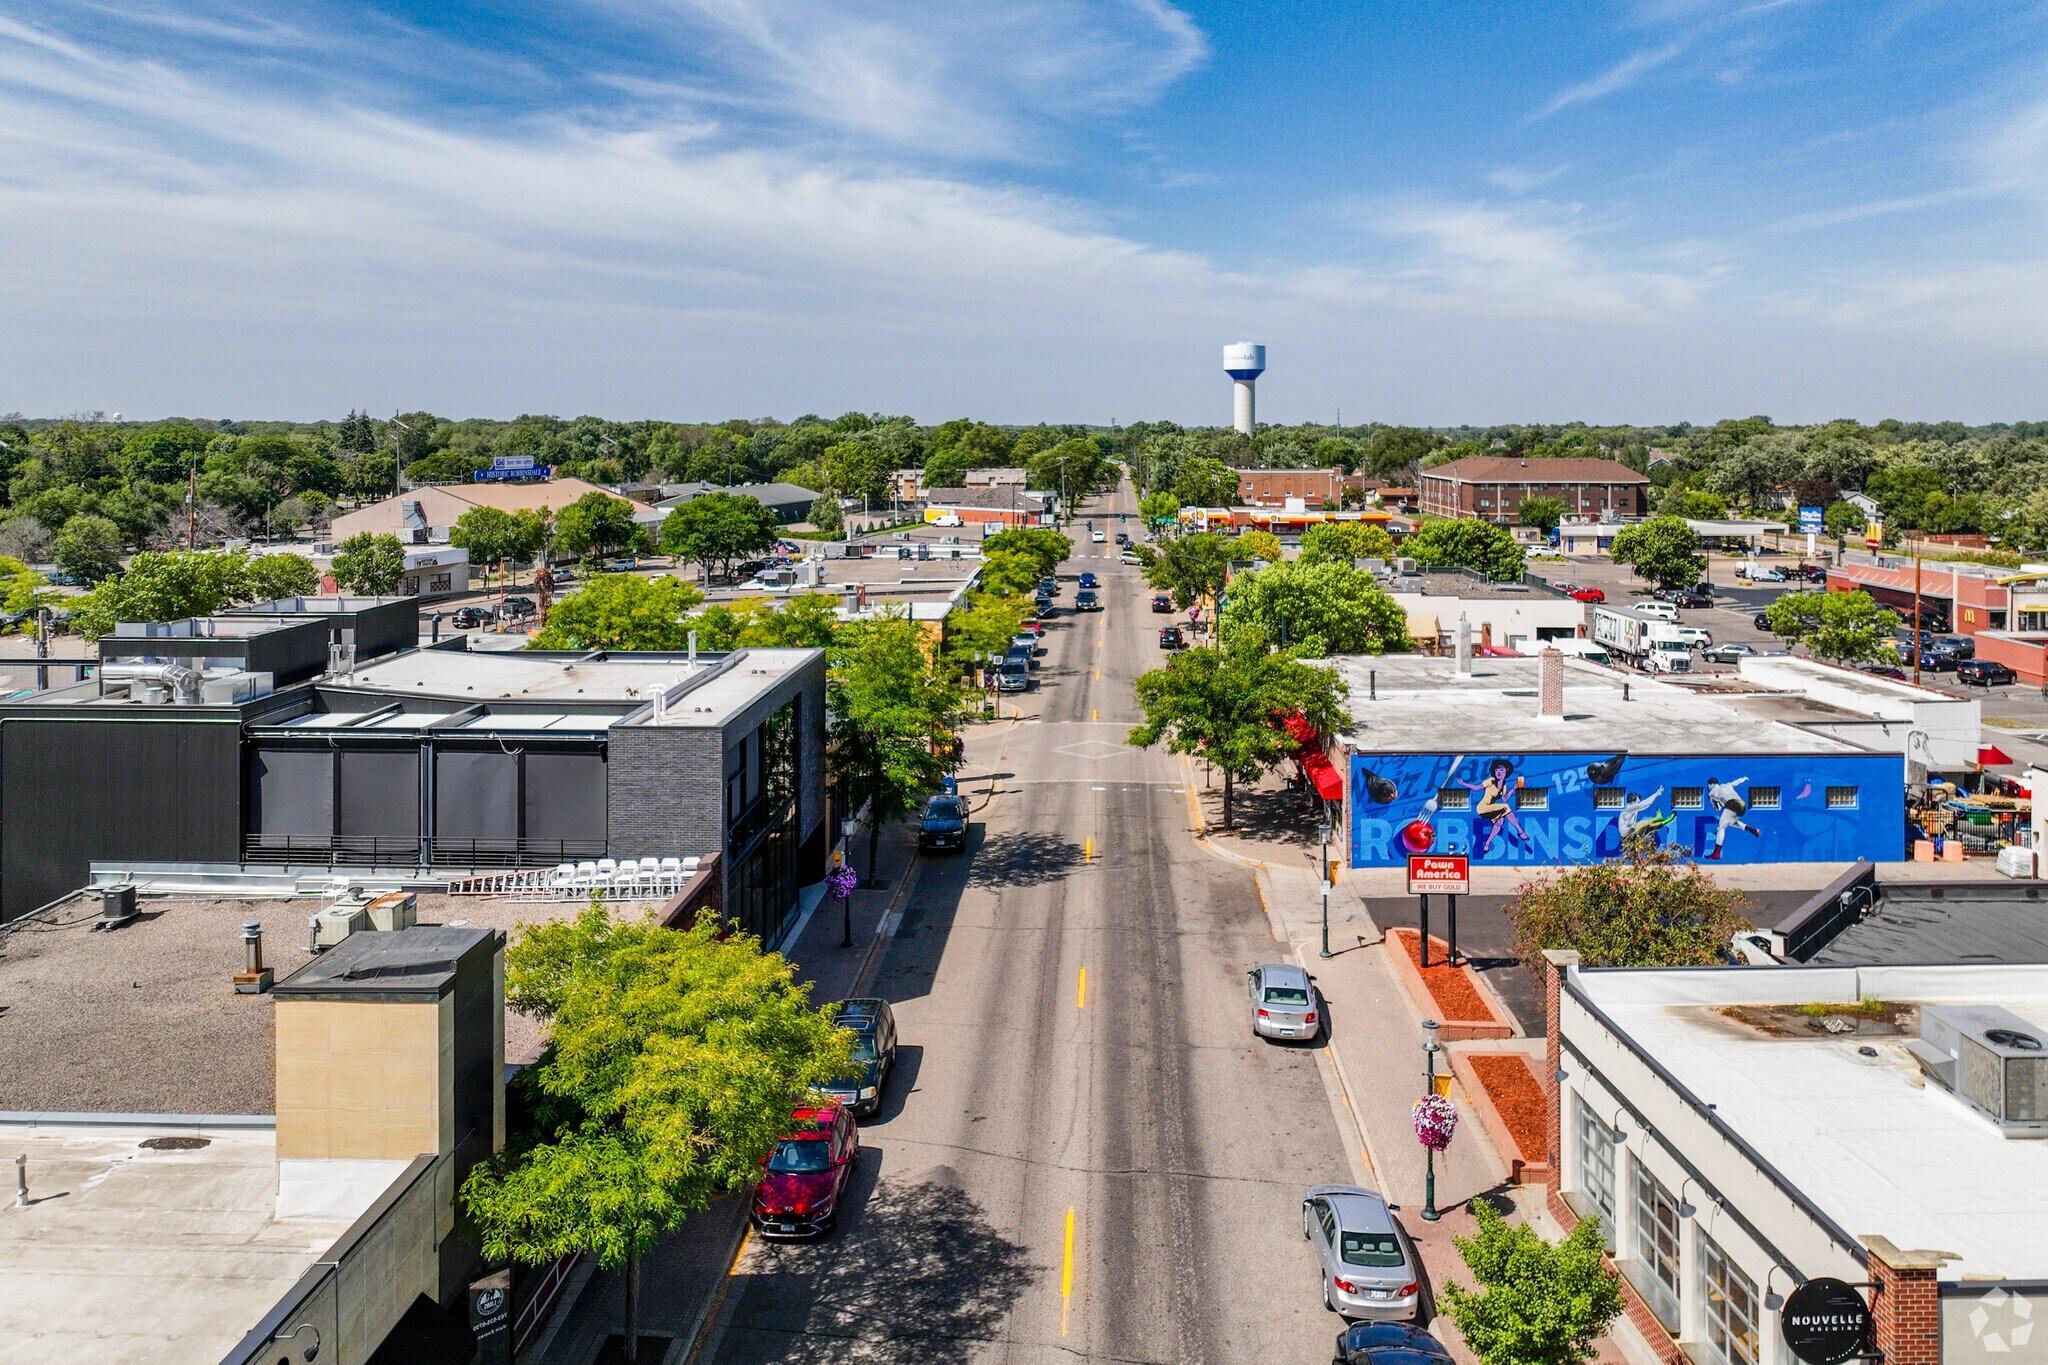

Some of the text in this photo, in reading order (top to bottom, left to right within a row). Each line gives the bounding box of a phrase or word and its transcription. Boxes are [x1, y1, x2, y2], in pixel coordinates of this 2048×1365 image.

[511, 469, 542, 477] ROBBINSDALE
[1424, 859, 1455, 869] Pawn
[1416, 869, 1461, 879] America
[1792, 1314, 1863, 1326] NOUVELLE
